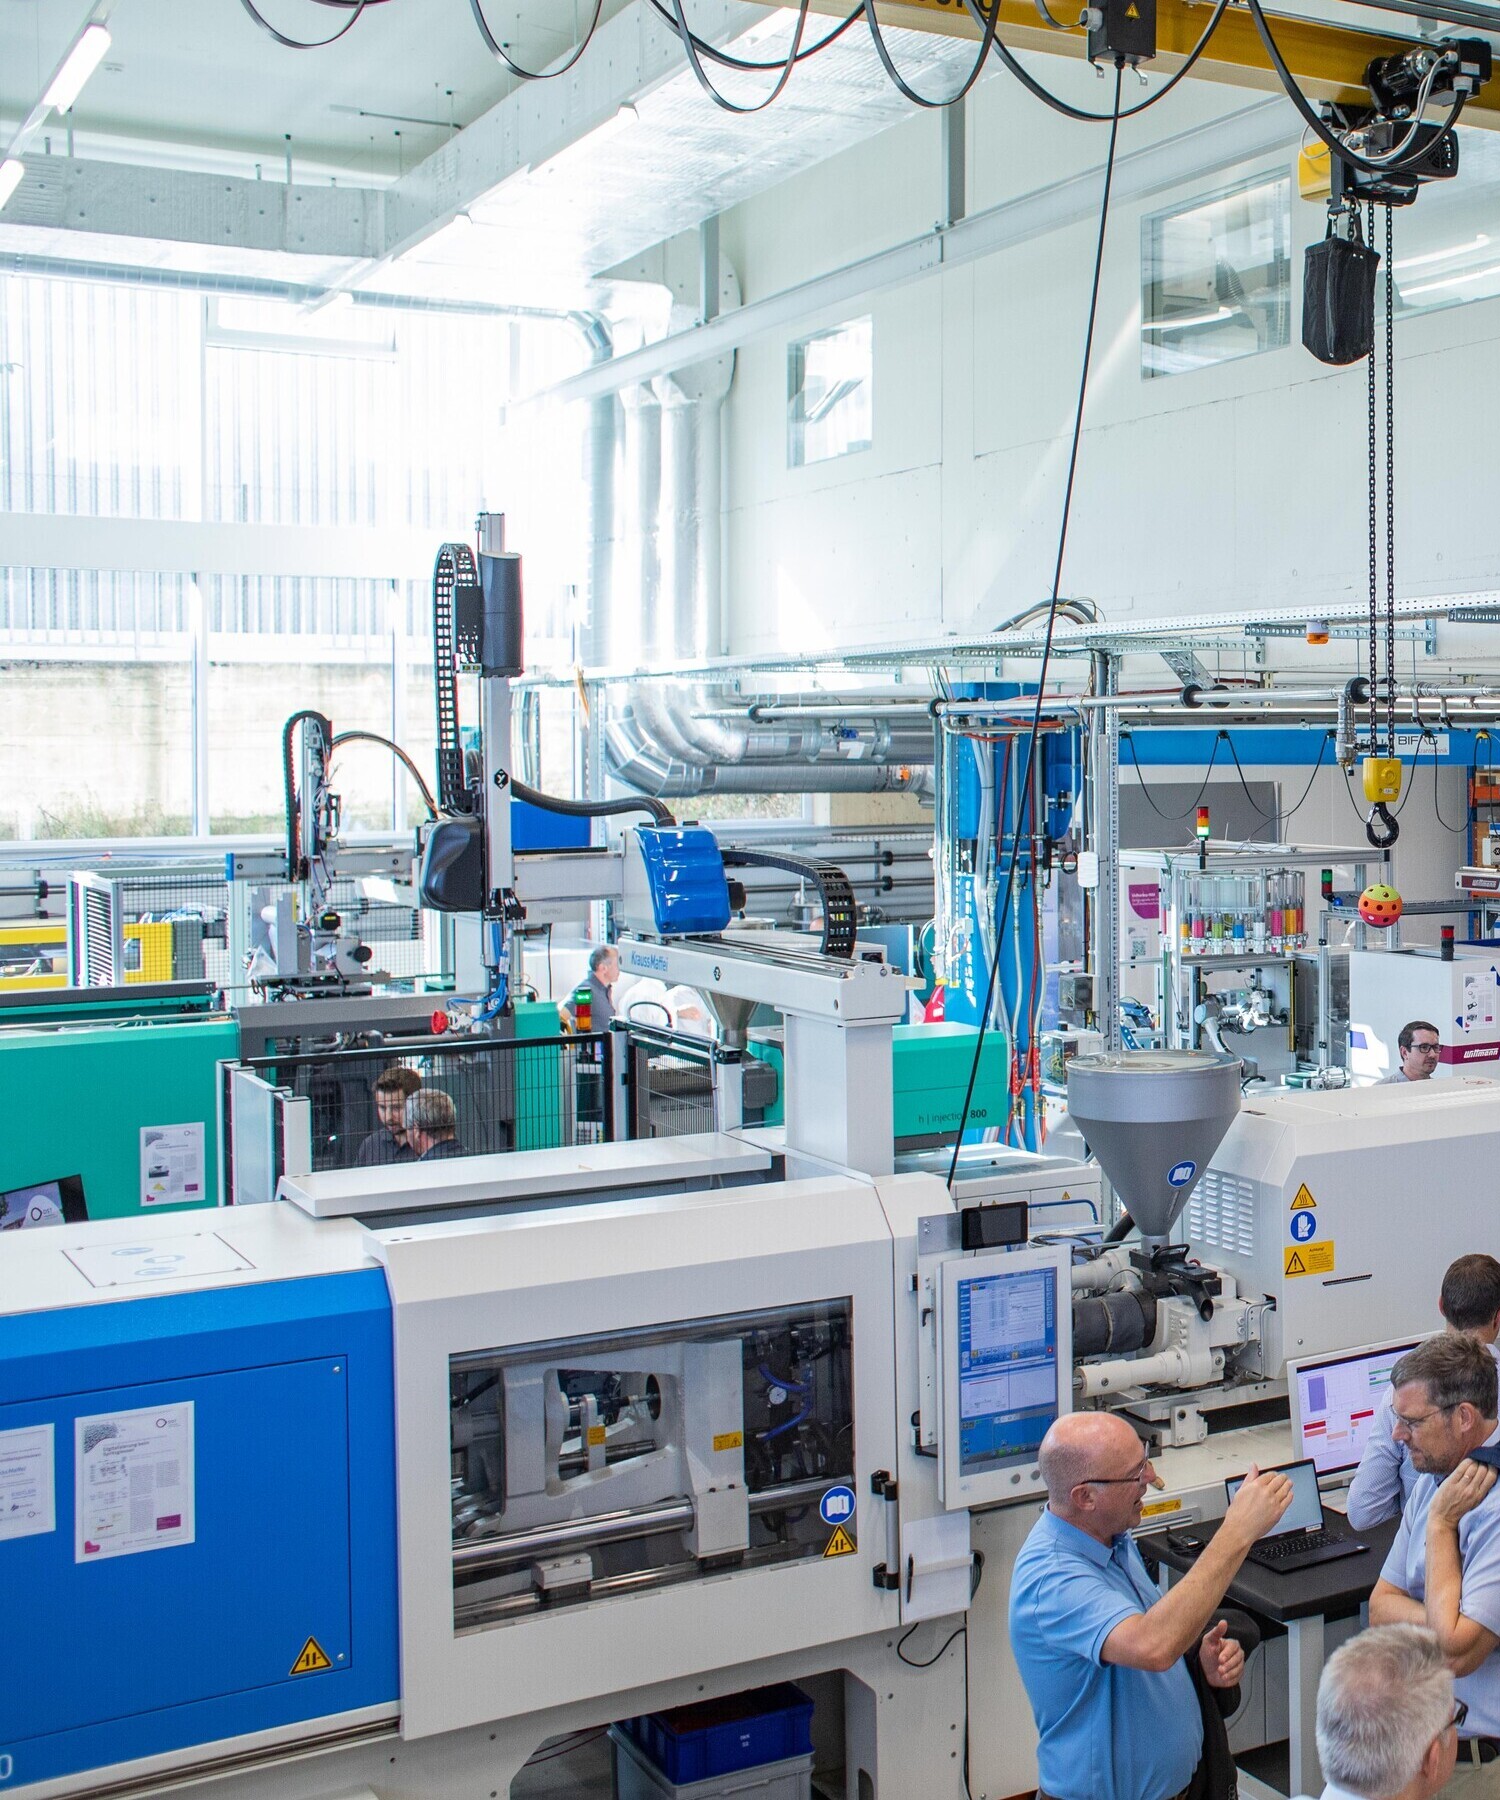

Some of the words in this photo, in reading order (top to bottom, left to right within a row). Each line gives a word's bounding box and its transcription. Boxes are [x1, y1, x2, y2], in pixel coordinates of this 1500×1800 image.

[1463, 1047, 1499, 1059] Wittmann
[931, 1111, 964, 1125] injectio
[970, 1109, 987, 1119] 800
